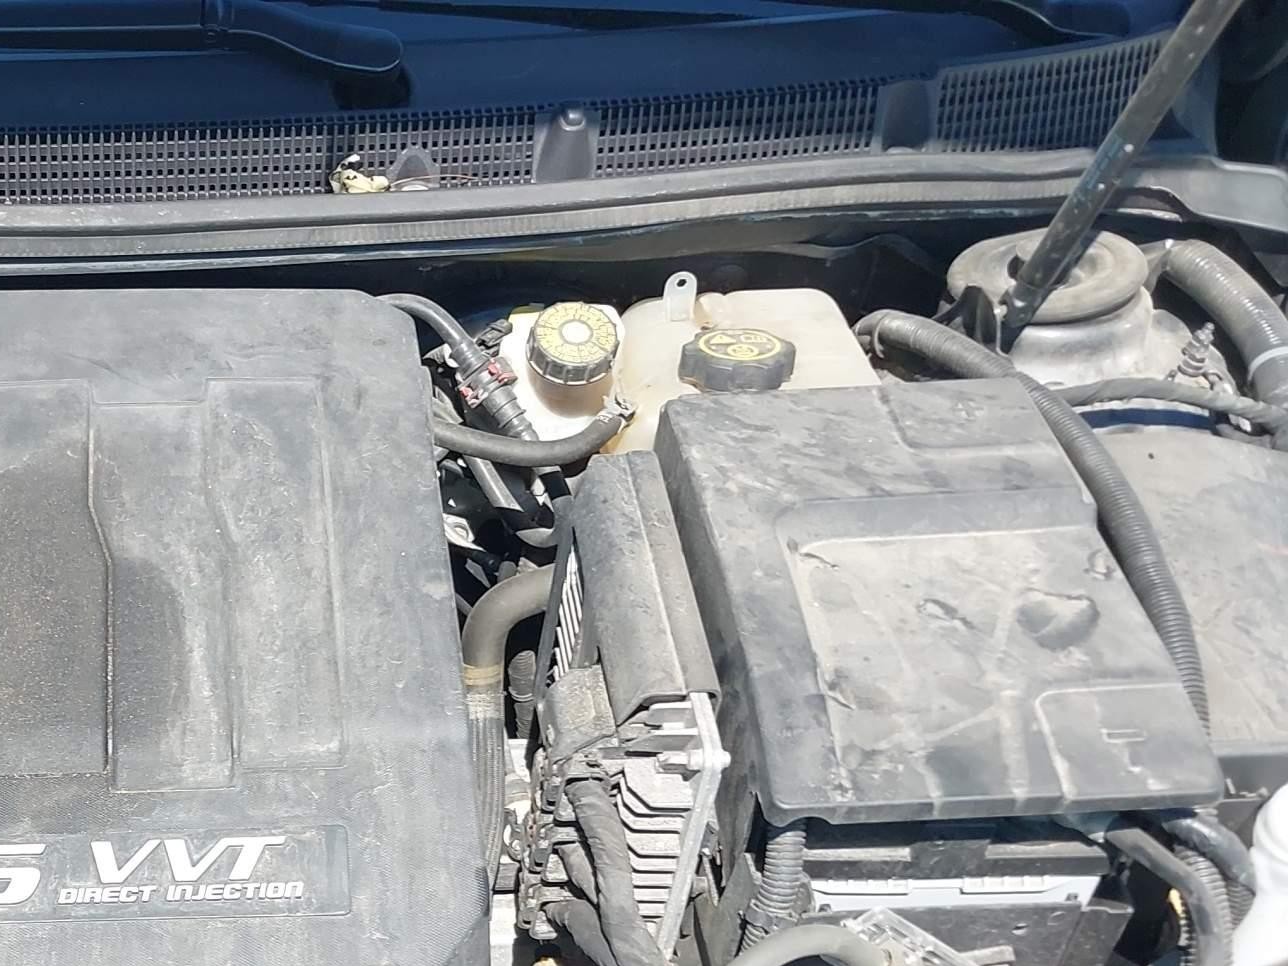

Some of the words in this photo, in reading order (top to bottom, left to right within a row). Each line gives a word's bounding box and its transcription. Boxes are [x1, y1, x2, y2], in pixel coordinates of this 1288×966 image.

[90, 836, 288, 884] VVT
[58, 885, 158, 905] DIRECT
[166, 881, 305, 903] INJECTION
